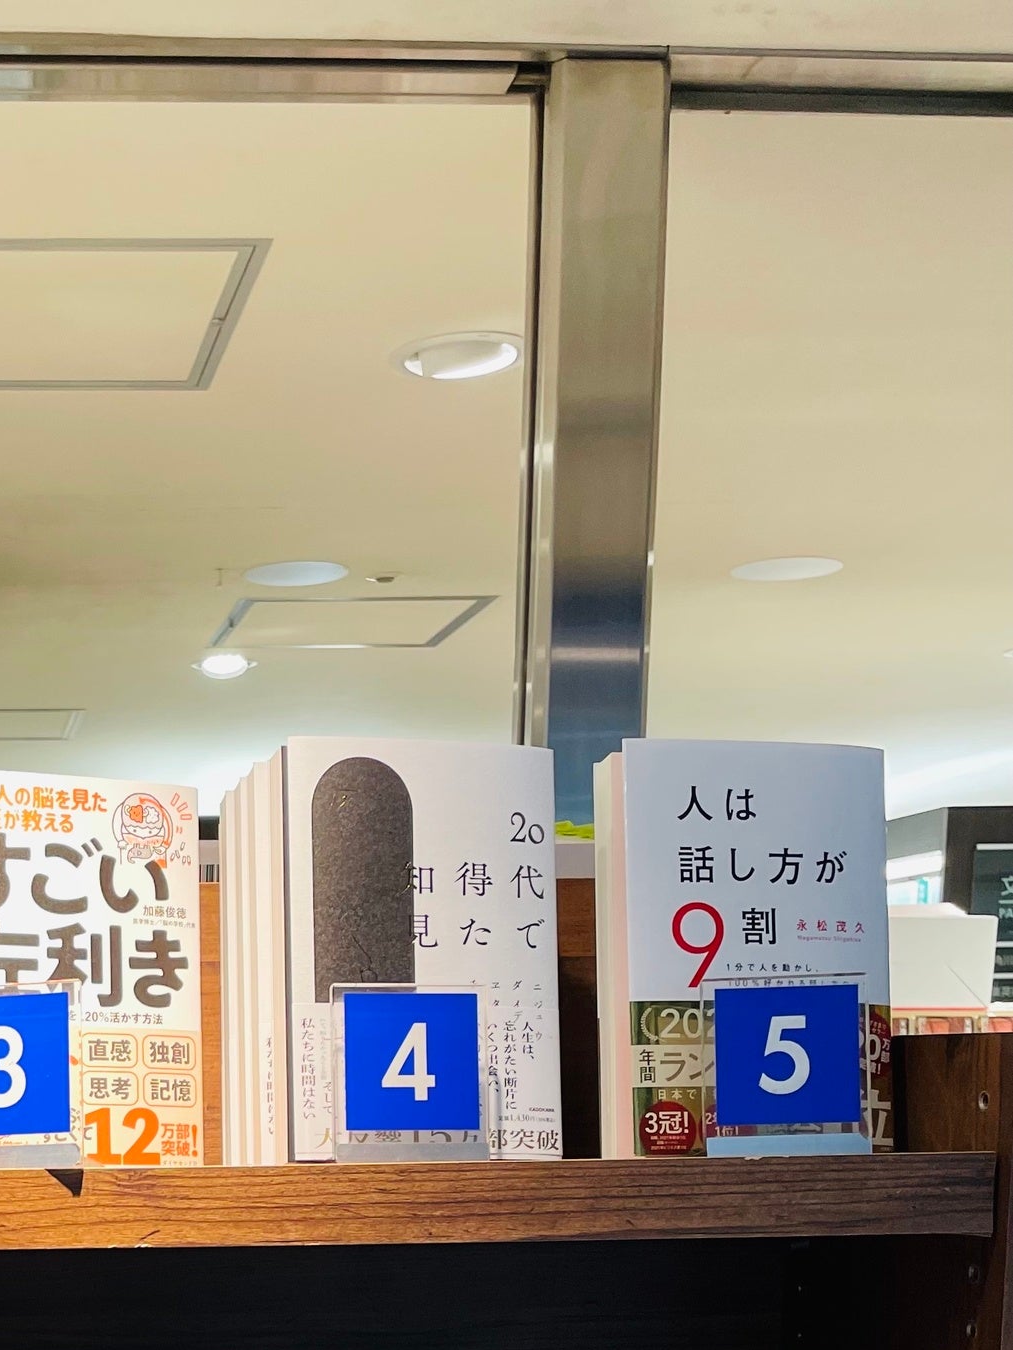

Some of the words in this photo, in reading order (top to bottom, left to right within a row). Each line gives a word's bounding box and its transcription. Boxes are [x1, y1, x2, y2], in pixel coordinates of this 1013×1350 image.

[677, 784, 757, 821] 人は
[678, 845, 848, 885] 話し方が
[142, 905, 187, 919] 加藤俊徳
[403, 861, 439, 950] 知見
[456, 861, 494, 948] 得た
[672, 901, 777, 989] 9割
[796, 918, 866, 936] 永松茂久
[87, 1038, 132, 1063] 直感
[148, 1040, 191, 1065] 独創
[521, 1020, 536, 1061] 人生は、
[757, 1014, 811, 1095] 5
[300, 1017, 317, 1120] 私たちに時間はない
[381, 1022, 436, 1101] 4
[503, 1020, 519, 1111] 忘れがたい断片に
[89, 1077, 132, 1101] 思考
[150, 1078, 192, 1103] 記憶
[85, 1107, 161, 1166] 12
[644, 1110, 690, 1135] 3冠!
